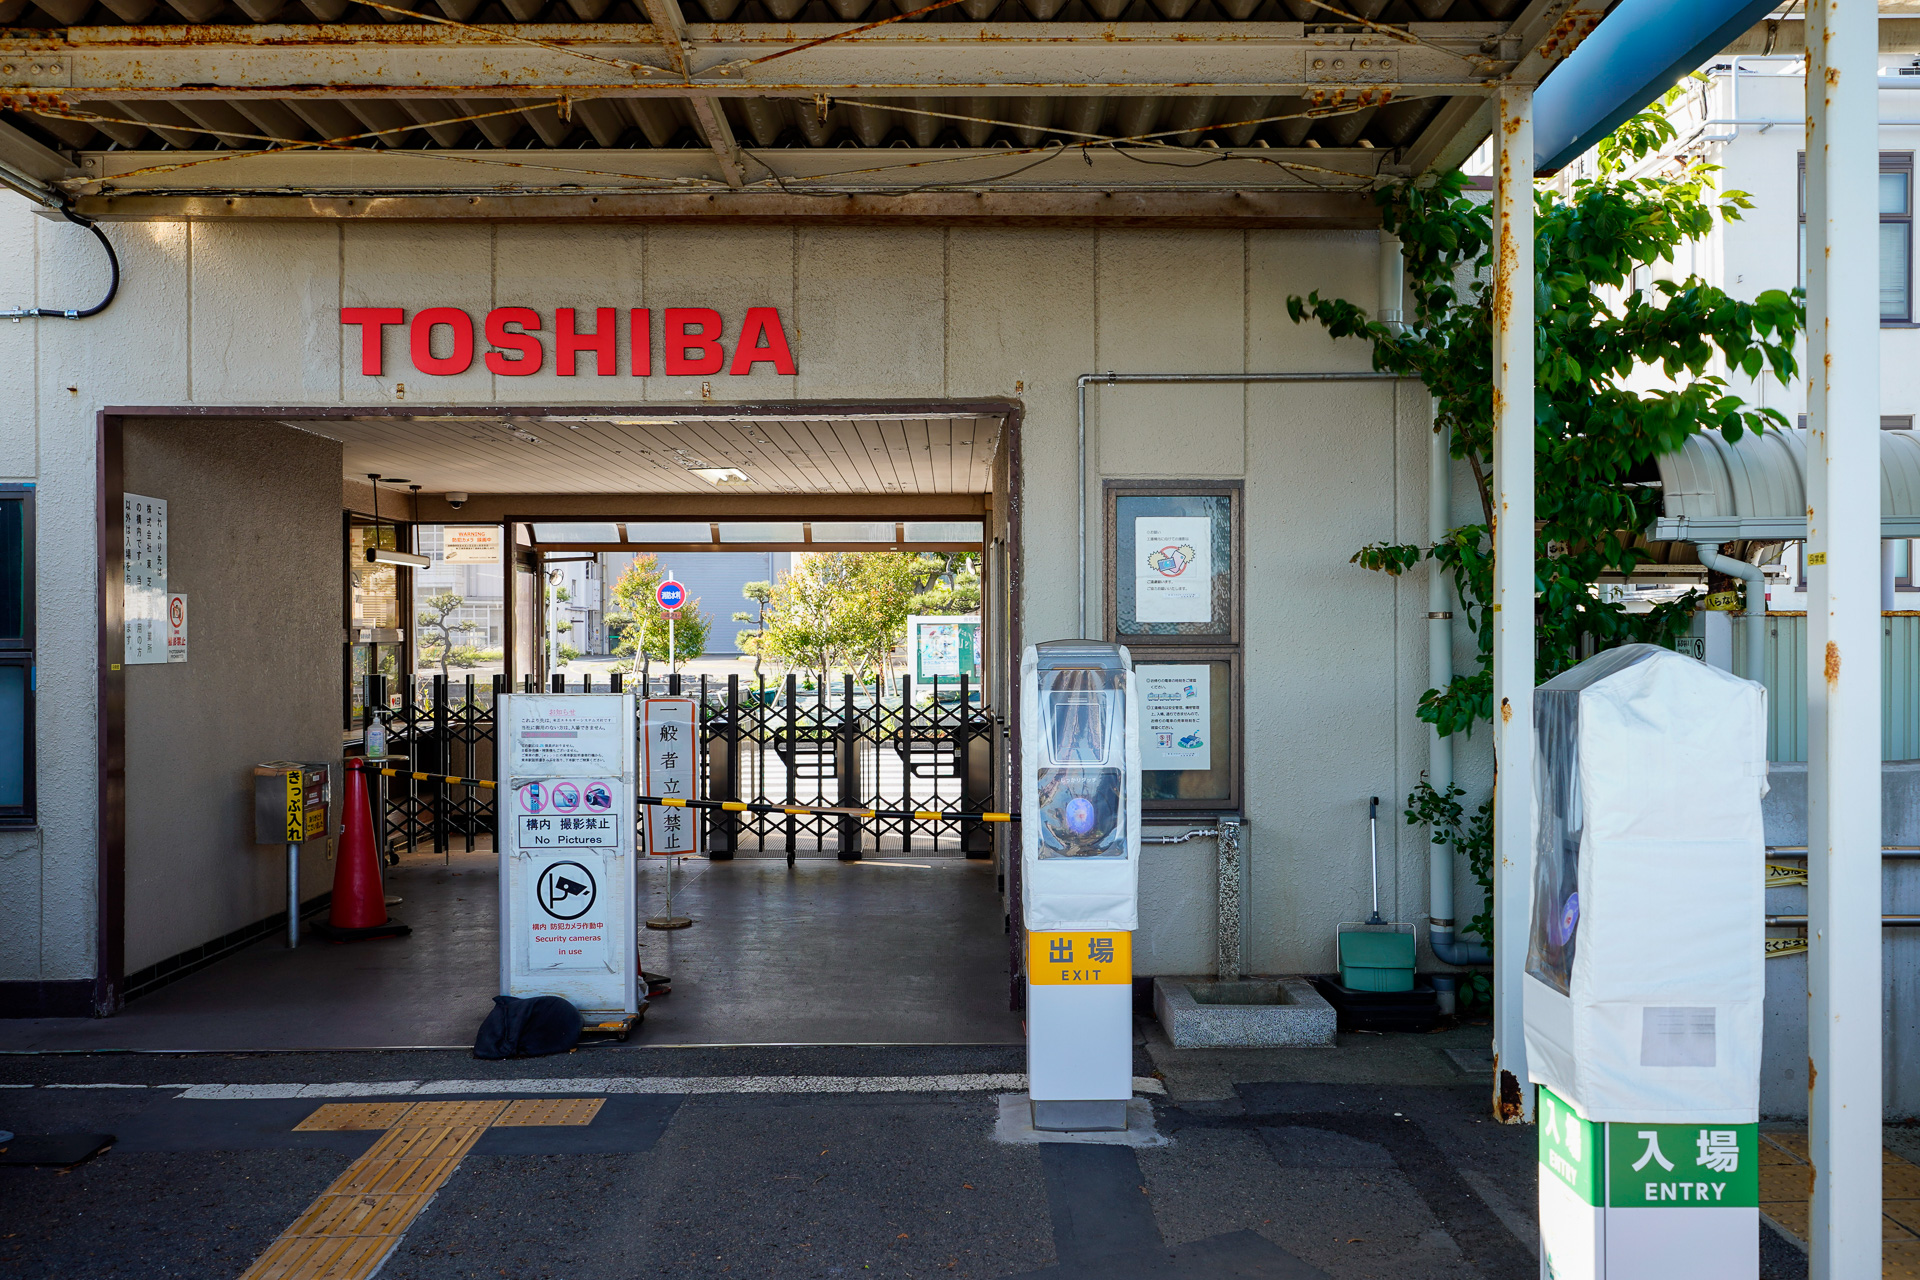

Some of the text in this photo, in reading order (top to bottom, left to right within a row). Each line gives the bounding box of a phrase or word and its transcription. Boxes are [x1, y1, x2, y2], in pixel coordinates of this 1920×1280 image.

[341, 307, 797, 377] TOSHIBA
[287, 771, 302, 840] きっぷ入れ
[526, 818, 610, 831] 構内 撮影禁止
[535, 835, 602, 844] No Pictures
[550, 922, 604, 930] 防犯カメラ作動中
[535, 935, 567, 943] Security
[1049, 938, 1114, 963] 出場
[1062, 970, 1102, 981] EXIT
[1631, 1129, 1740, 1173] 入場
[1549, 1148, 1578, 1186] ENTRY
[1645, 1182, 1727, 1201] ENTRY
